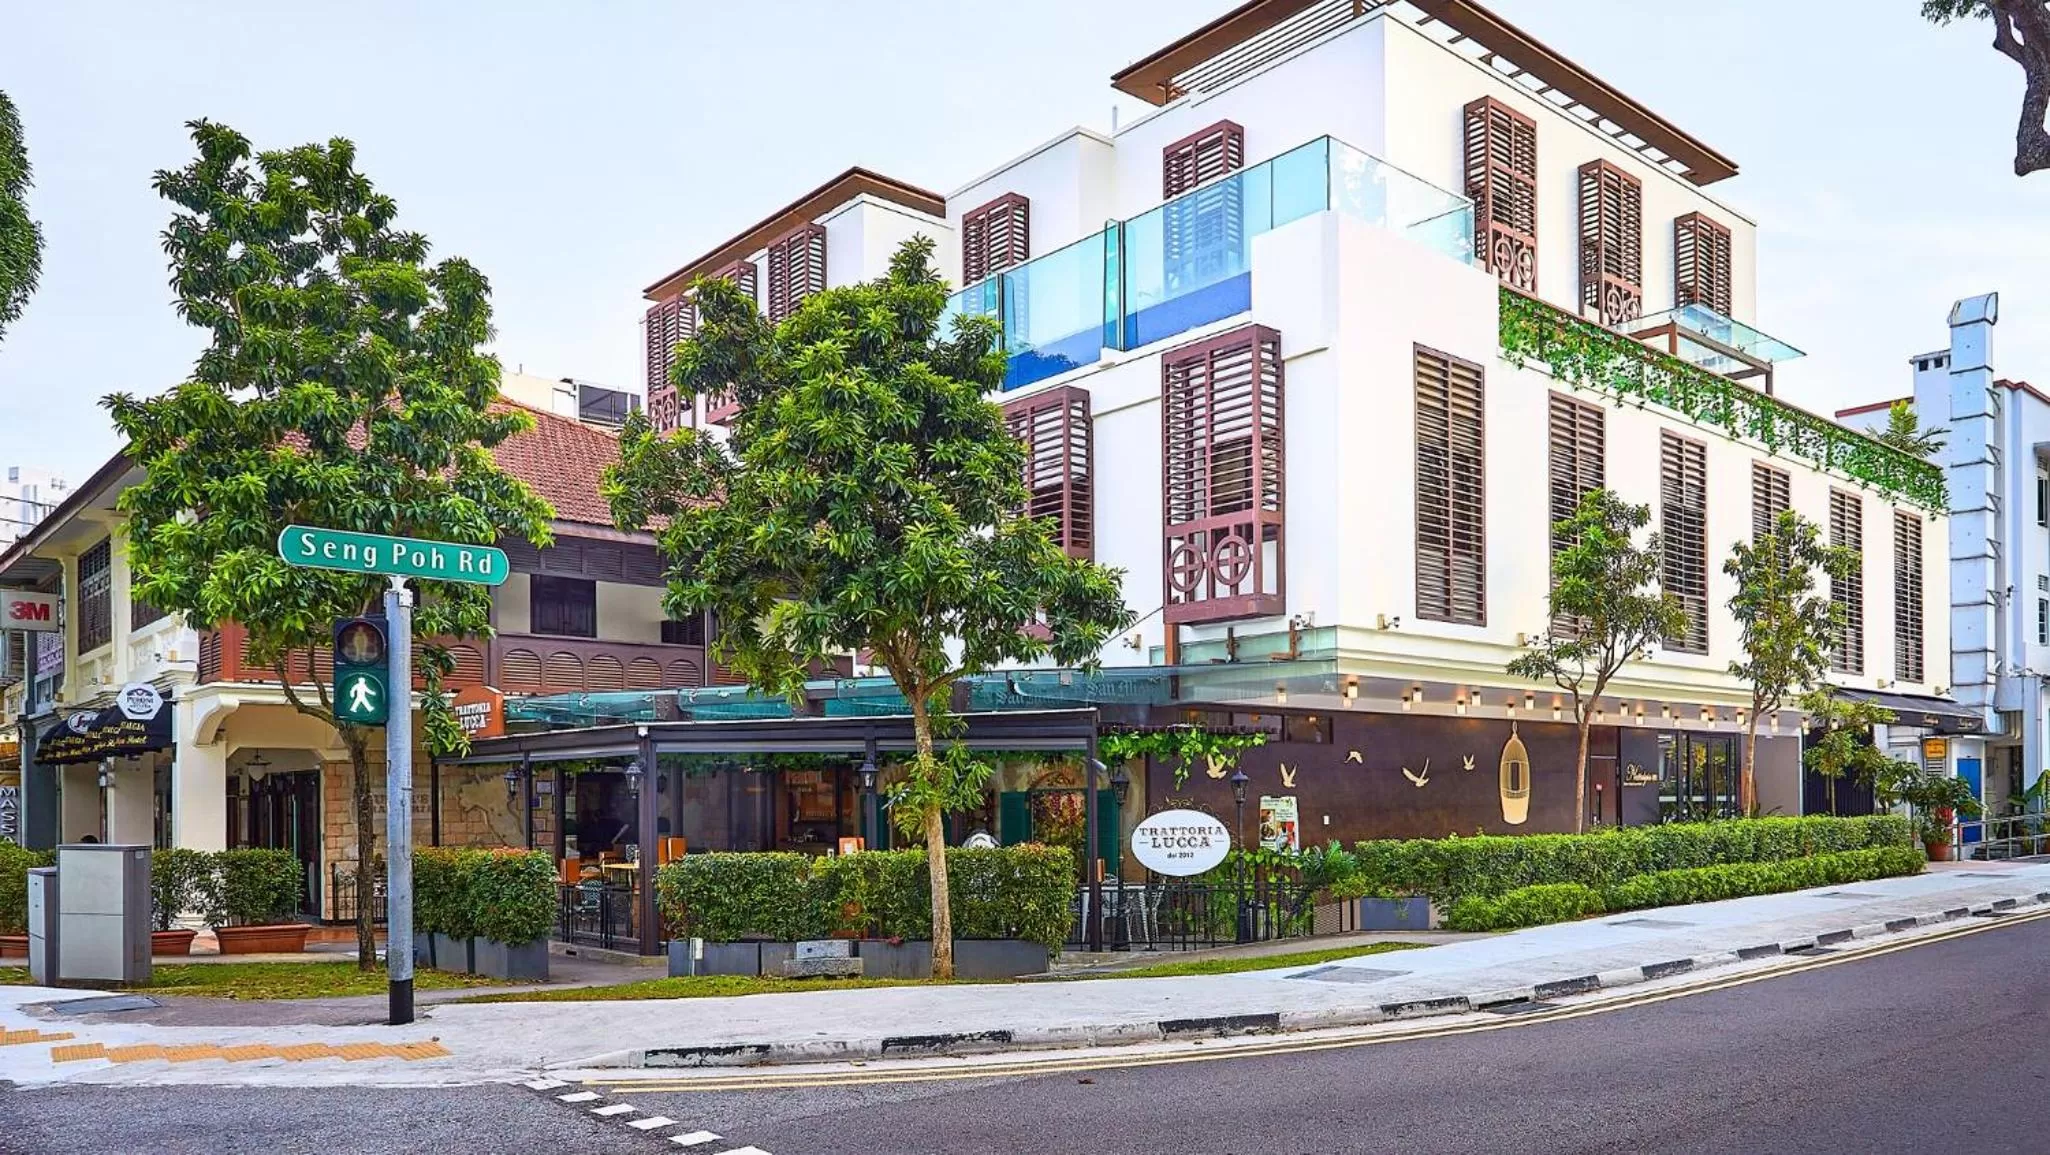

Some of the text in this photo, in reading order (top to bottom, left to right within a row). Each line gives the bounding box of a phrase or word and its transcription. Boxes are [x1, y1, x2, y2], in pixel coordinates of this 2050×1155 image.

[300, 532, 492, 575] Seng Poh Rd
[9, 601, 50, 620] 3M
[1139, 826, 1224, 837] TRATTORIA
[1151, 837, 1212, 849] LUCCA
